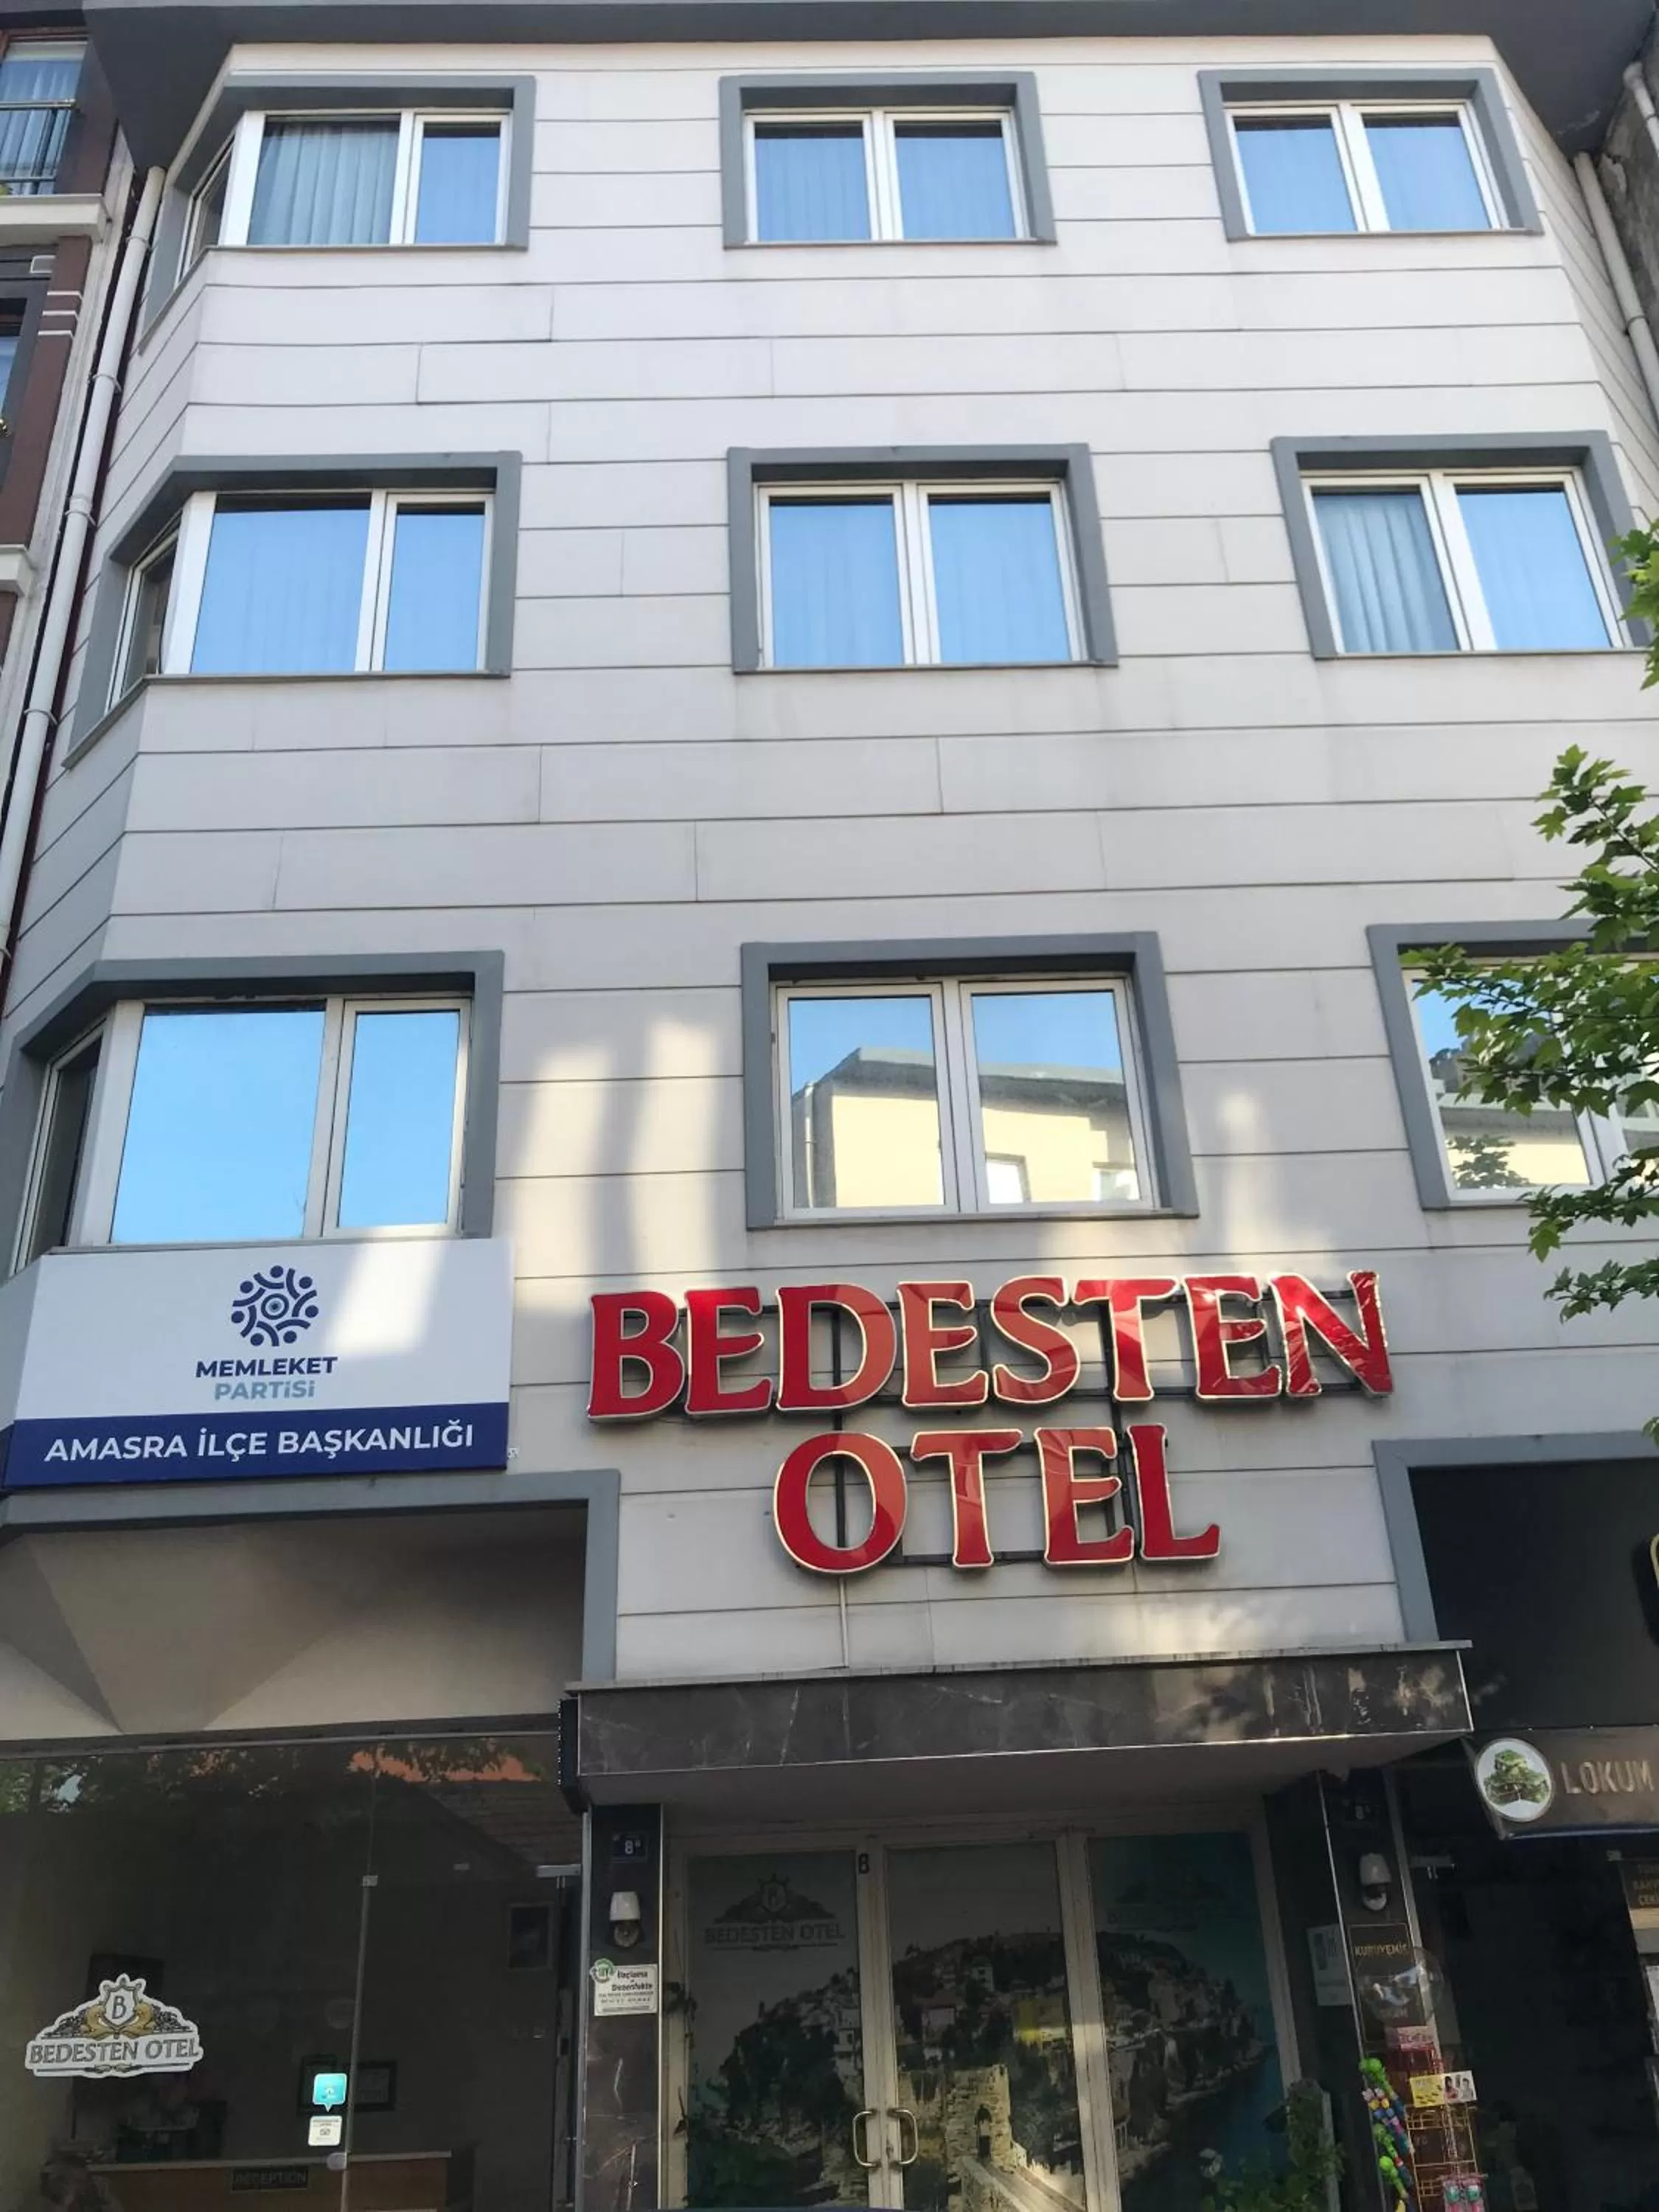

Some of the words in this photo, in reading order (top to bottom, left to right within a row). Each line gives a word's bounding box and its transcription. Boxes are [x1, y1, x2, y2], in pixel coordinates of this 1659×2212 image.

[587, 1271, 1396, 1422] BEDESTEN
[195, 1356, 338, 1377] MEMLEKET
[44, 1436, 188, 1462] AMASRA
[197, 1427, 266, 1463] İLÇE
[278, 1418, 474, 1459] BAŞKANLIĞI
[773, 1423, 1220, 1575] OTEL
[1560, 1760, 1655, 1794] LOKUM
[704, 1924, 794, 1944] BEDESTEN
[800, 1921, 844, 1941] OTEL
[112, 1995, 127, 2020] B
[29, 2040, 138, 2064] BEDESTEN
[145, 2037, 199, 2059] OTEL
